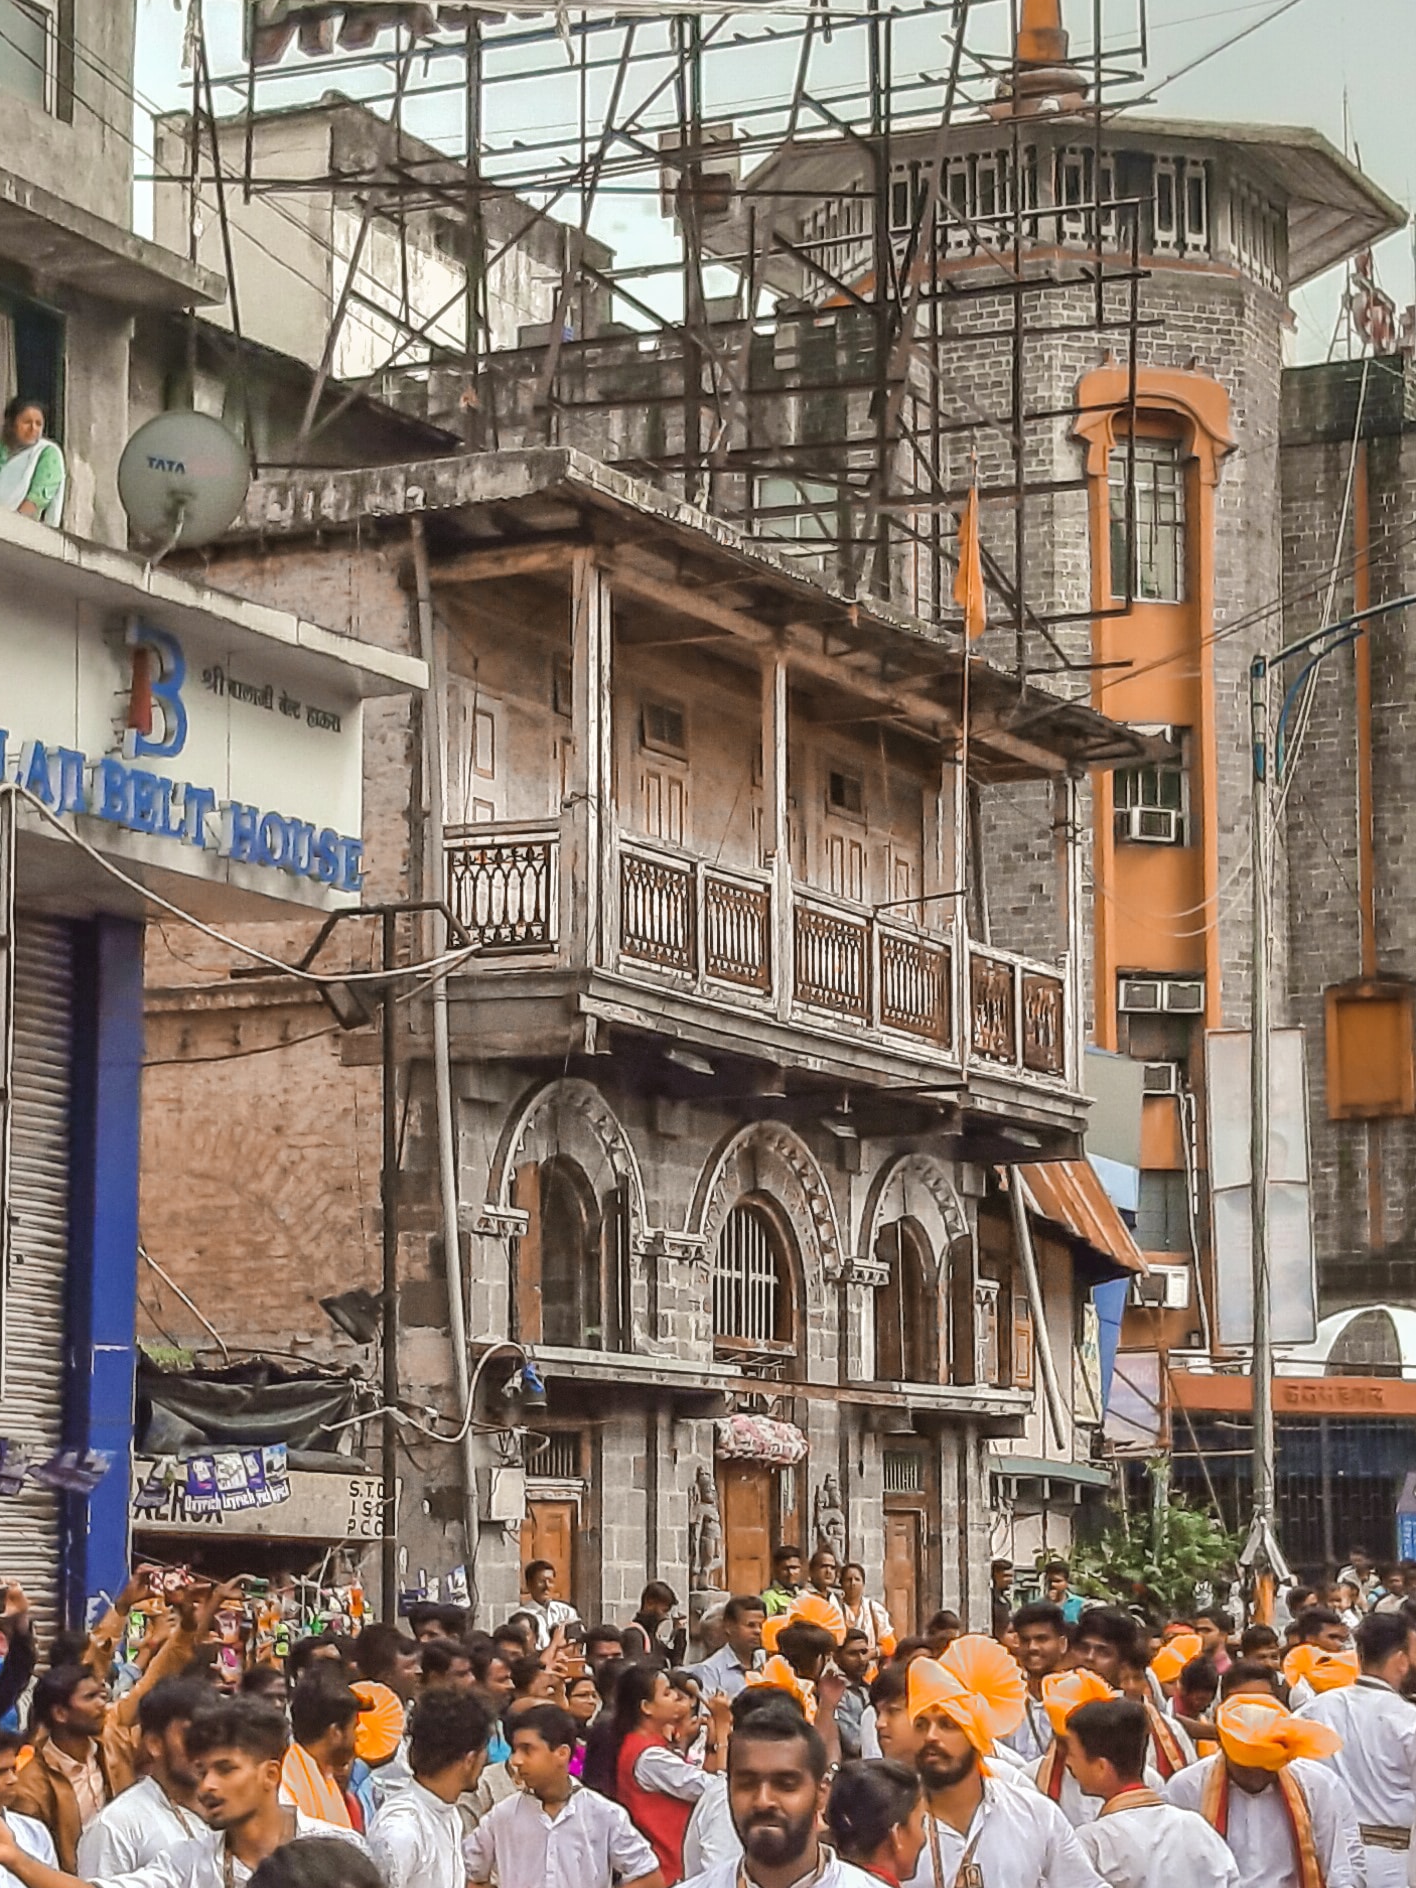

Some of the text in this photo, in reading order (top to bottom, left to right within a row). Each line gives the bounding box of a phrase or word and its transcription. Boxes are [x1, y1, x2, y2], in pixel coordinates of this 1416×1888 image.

[147, 457, 186, 474] TATA
[97, 757, 216, 847] BELT
[222, 800, 364, 892] HOUSE
